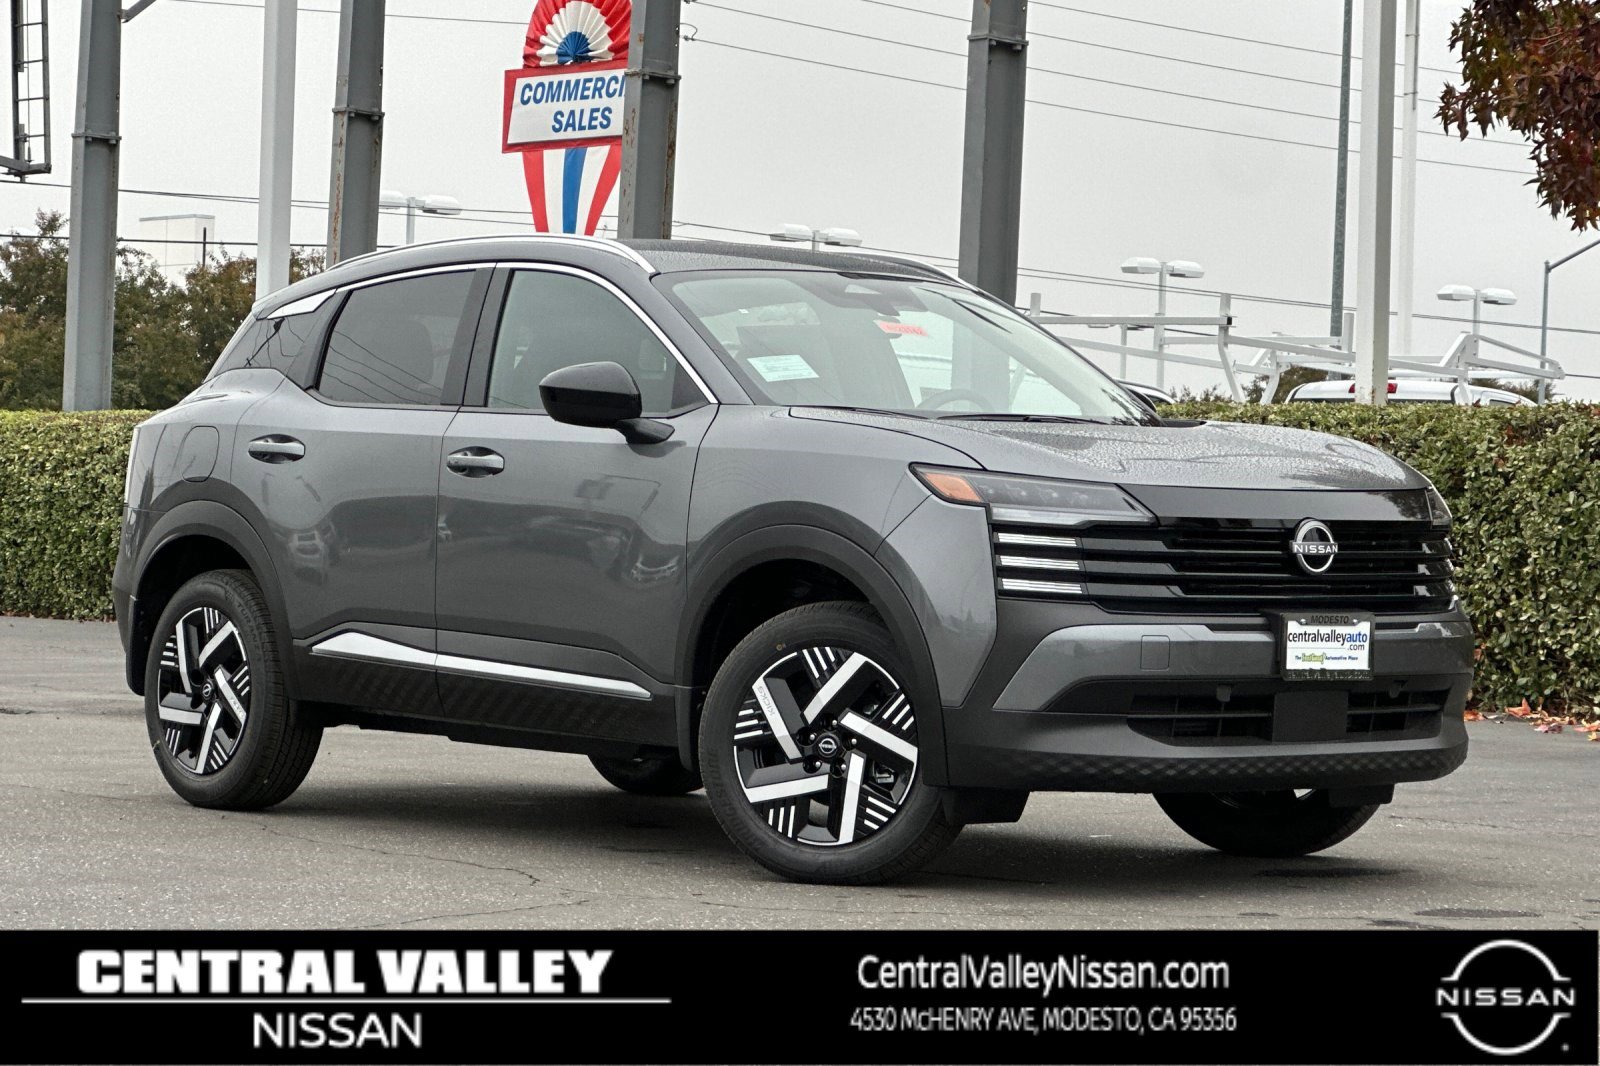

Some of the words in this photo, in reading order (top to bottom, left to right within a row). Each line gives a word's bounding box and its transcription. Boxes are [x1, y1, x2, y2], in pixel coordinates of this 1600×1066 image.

[520, 75, 626, 105] COMMERCI
[552, 106, 612, 133] SALES
[1294, 544, 1338, 553] NISSAN
[1310, 615, 1350, 624] MODESTO
[1287, 629, 1368, 646] centralvalleyauto
[1347, 643, 1365, 651] .com
